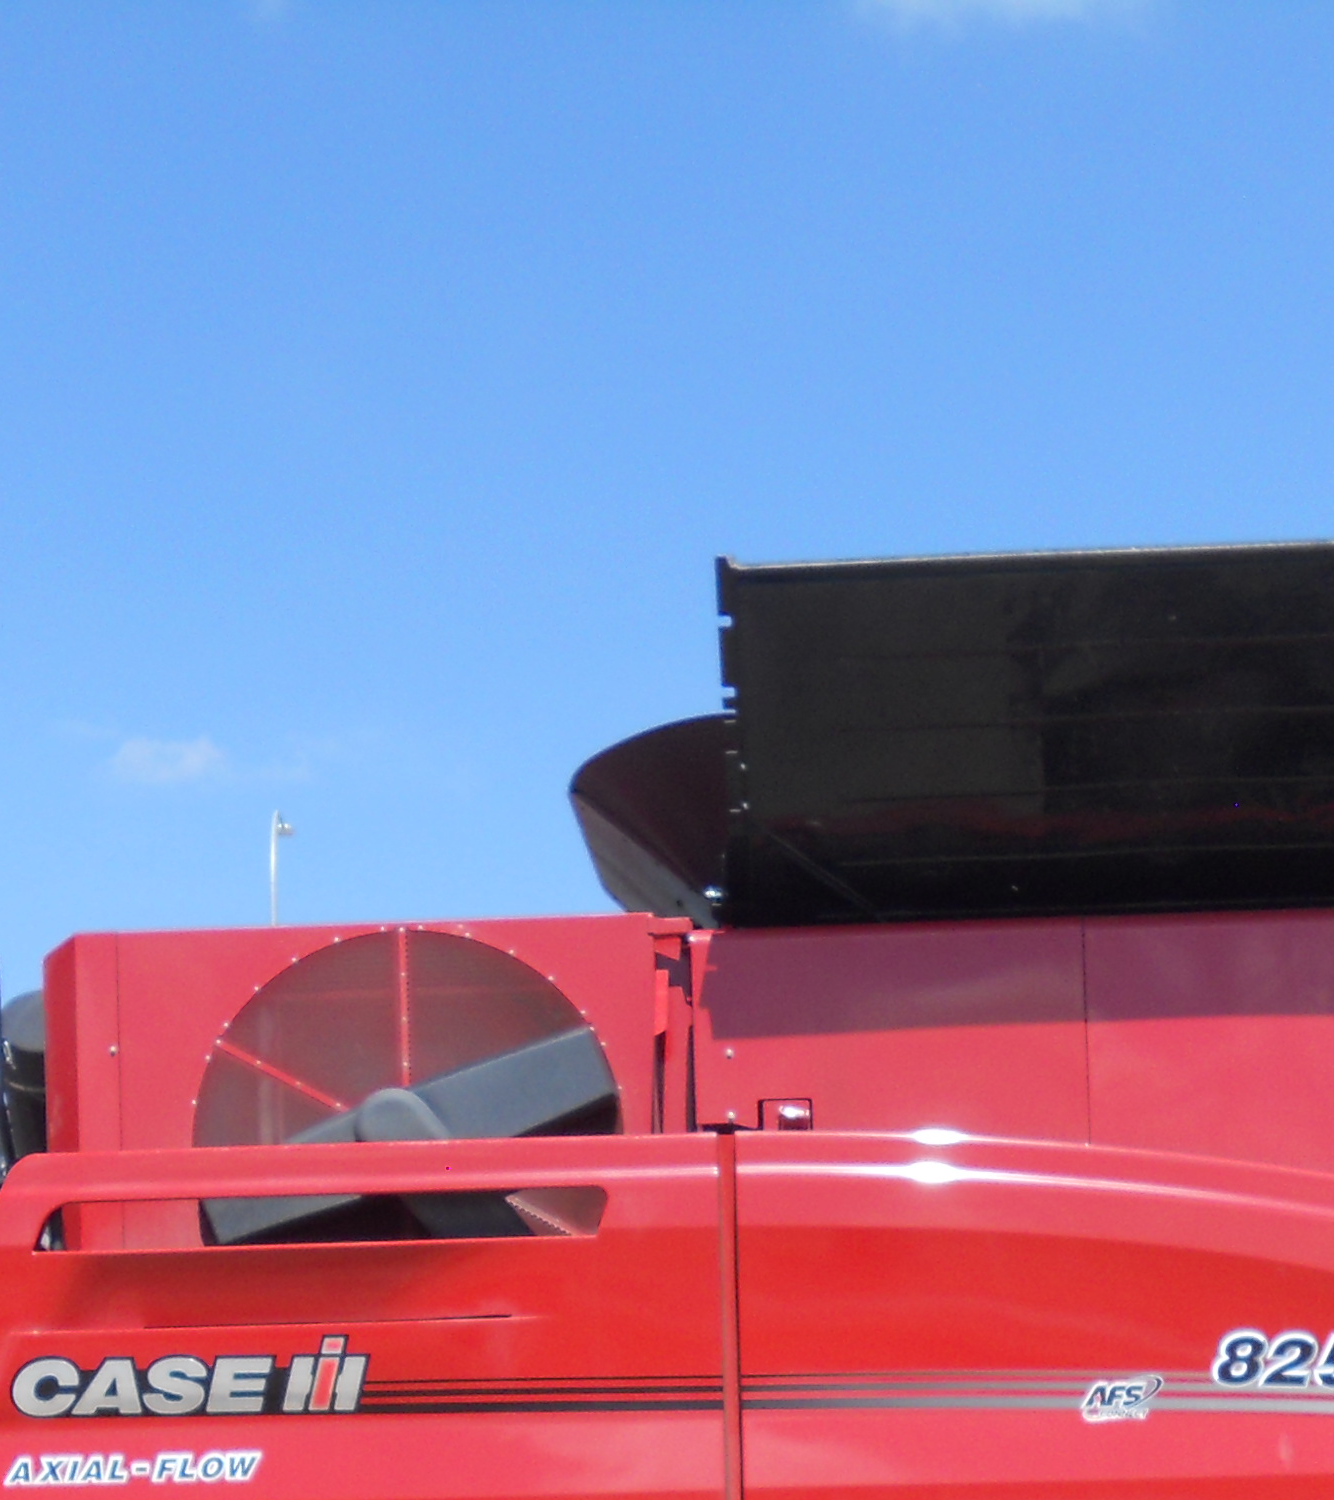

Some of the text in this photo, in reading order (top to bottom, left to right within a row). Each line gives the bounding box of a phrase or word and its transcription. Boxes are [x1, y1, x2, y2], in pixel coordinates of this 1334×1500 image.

[12, 1355, 274, 1417] CASE
[1084, 1383, 1145, 1407] AFS
[5, 1450, 262, 1486] AXIAL-FLOW
